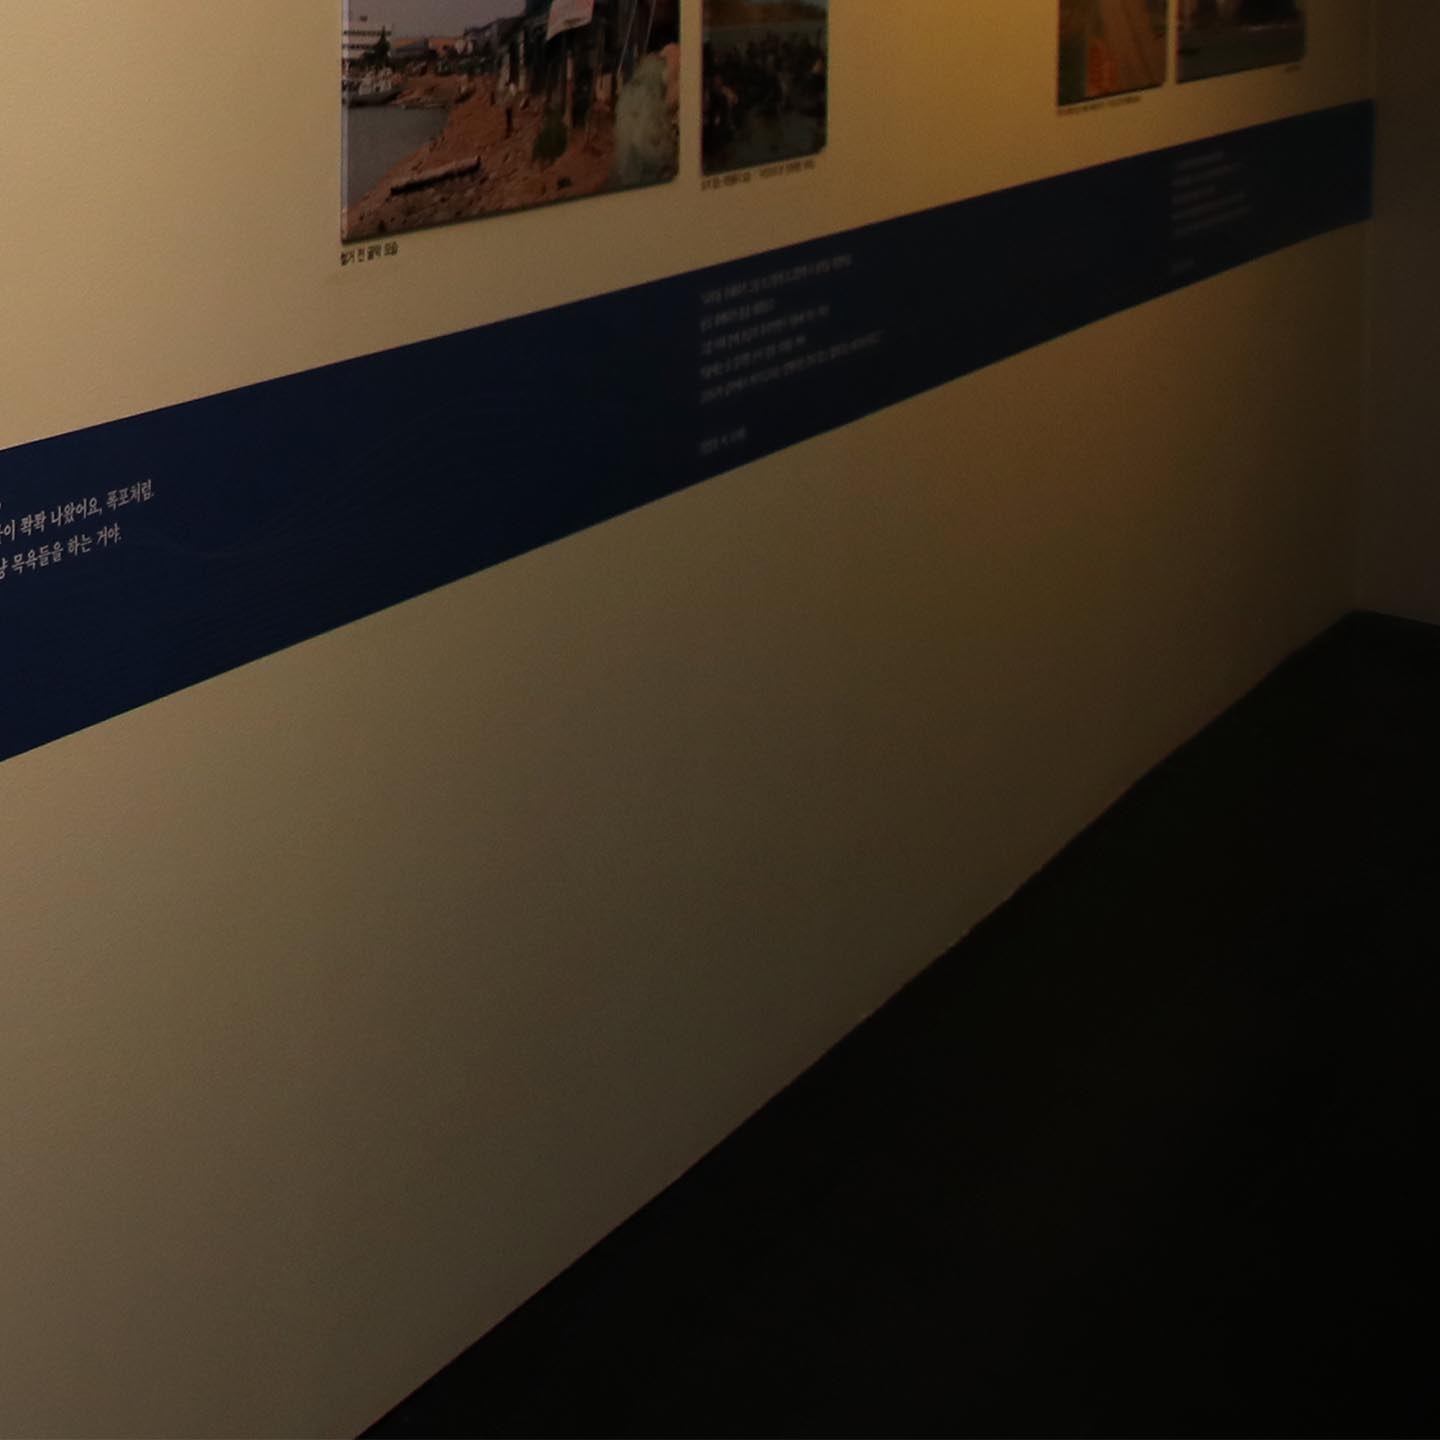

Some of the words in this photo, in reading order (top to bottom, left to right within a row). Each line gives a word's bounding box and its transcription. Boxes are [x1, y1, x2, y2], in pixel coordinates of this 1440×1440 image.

[10, 540, 65, 575] 목욕들을
[66, 533, 93, 557] 하는
[95, 521, 123, 548] 거야.
